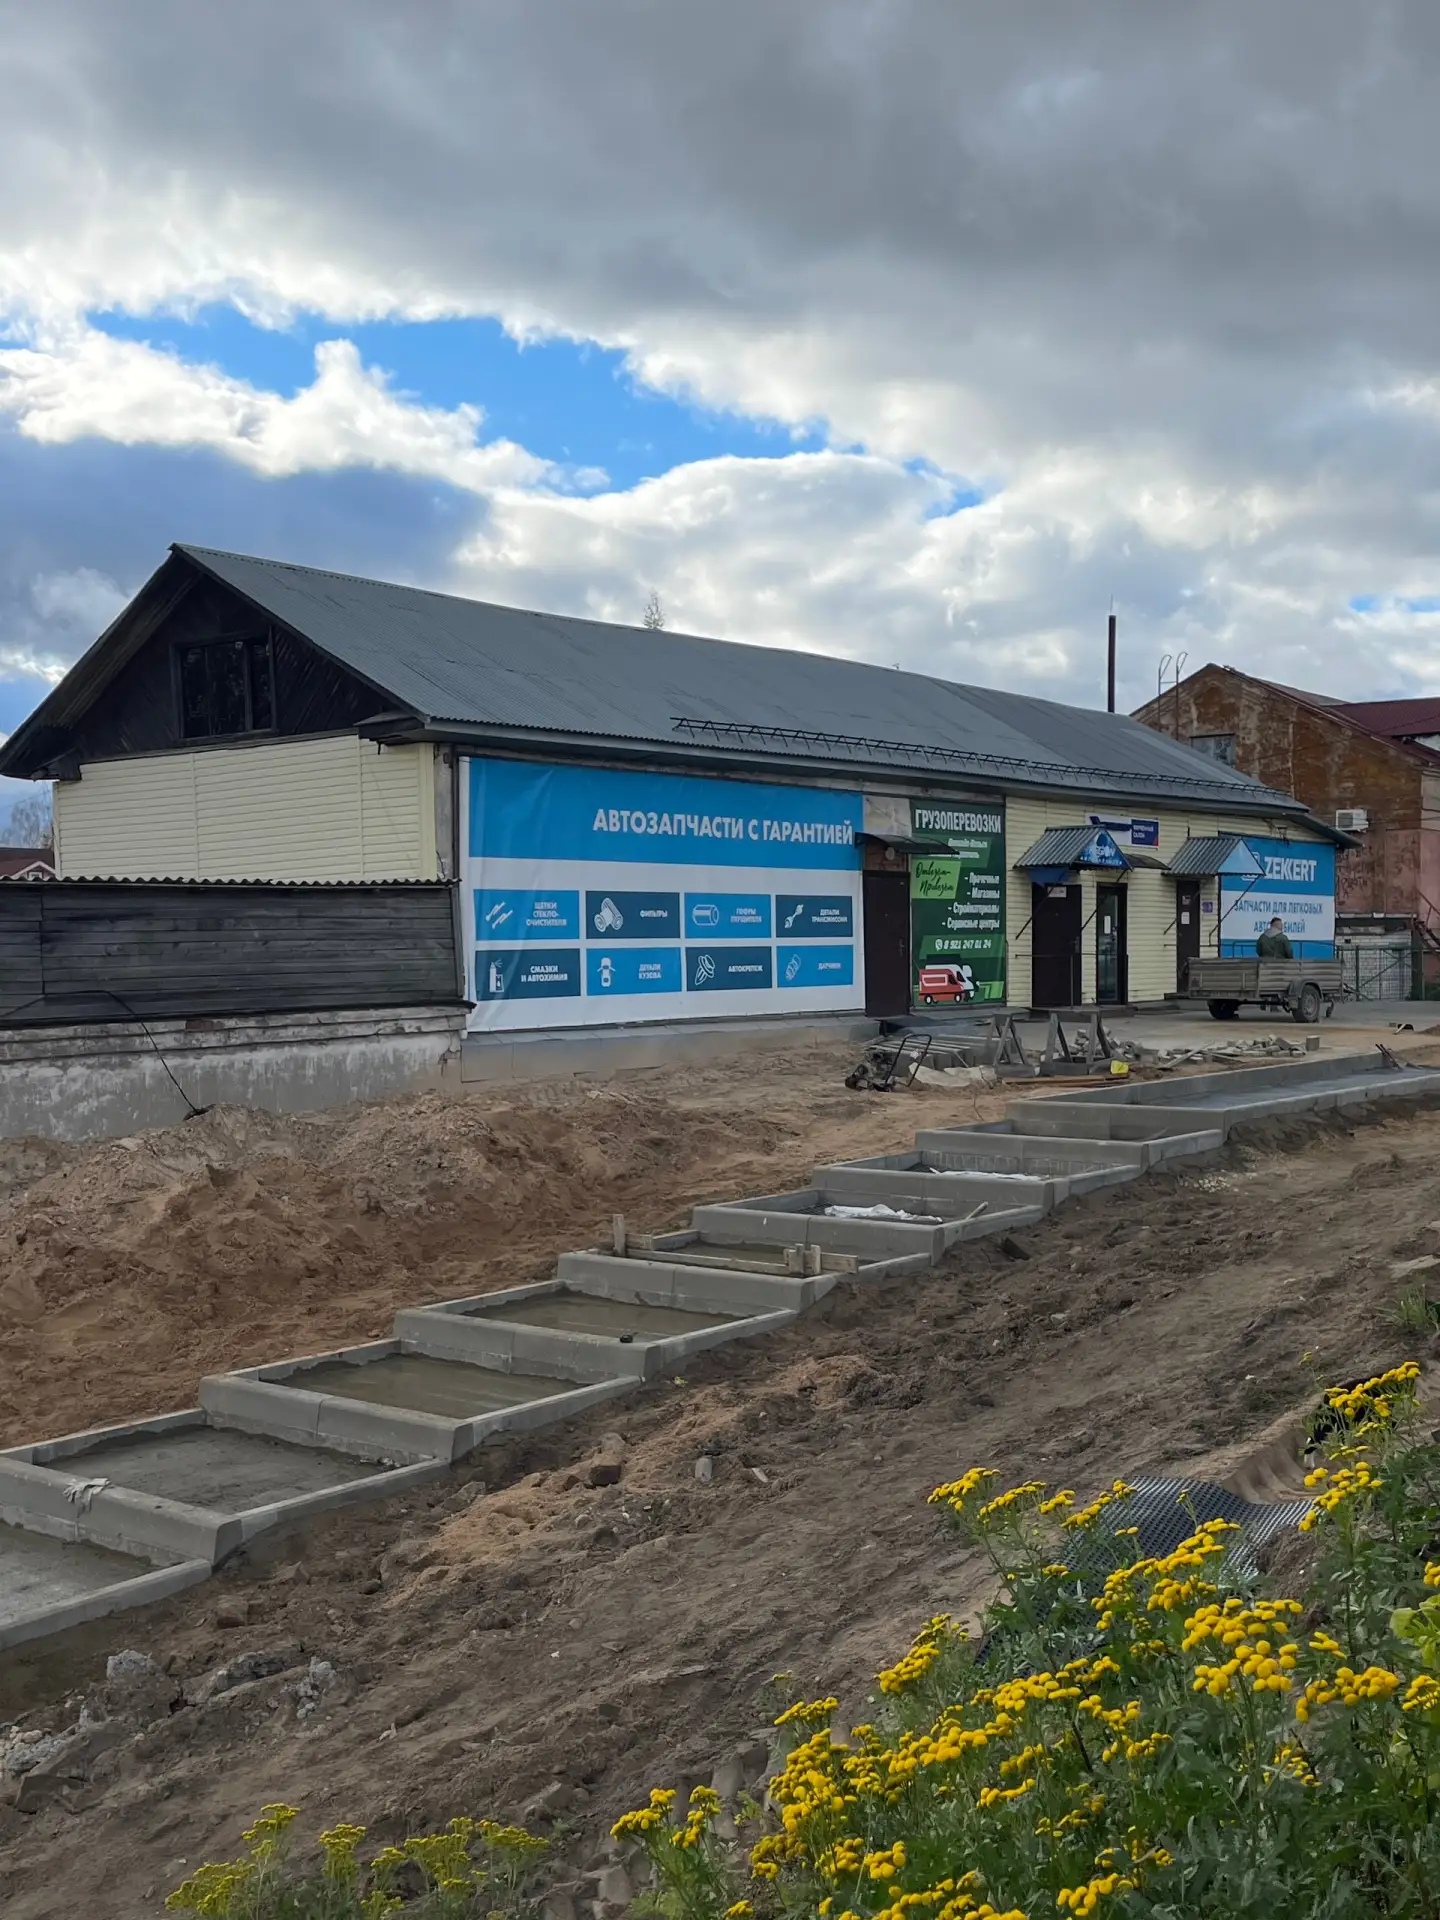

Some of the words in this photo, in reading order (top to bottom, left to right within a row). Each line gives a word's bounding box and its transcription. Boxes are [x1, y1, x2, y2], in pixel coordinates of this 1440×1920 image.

[915, 809, 1001, 833] ГРУЗОПЕРЕВОЗКИ
[593, 809, 744, 839] АВТОЗАПЧАСТИ
[748, 820, 759, 840] С
[763, 820, 853, 845] ГАРАНТИЕЙ
[1264, 856, 1317, 882] ZEKKERT
[971, 887, 1000, 899] Магазины
[819, 908, 840, 916] ДЕТАЛИ
[1234, 900, 1271, 913] ЗАПЧАСТИ
[1272, 901, 1287, 915] ДЛЯ
[1288, 902, 1323, 914] ЛЕГКОВЫХ
[639, 909, 668, 918] ФИЛЬТРЫ
[811, 915, 848, 923] ТРАНСМИССИИ
[979, 919, 1000, 930] центры
[963, 939, 974, 949] 247
[982, 939, 992, 949] 24
[530, 965, 559, 974] СМАЗКИ
[728, 964, 763, 973] АВТОКРЕПЕЖ
[818, 962, 842, 970] ДАТЧИКИ
[527, 973, 568, 982] АВТОХИМИЯ
[639, 971, 662, 979] КУЗОВА
